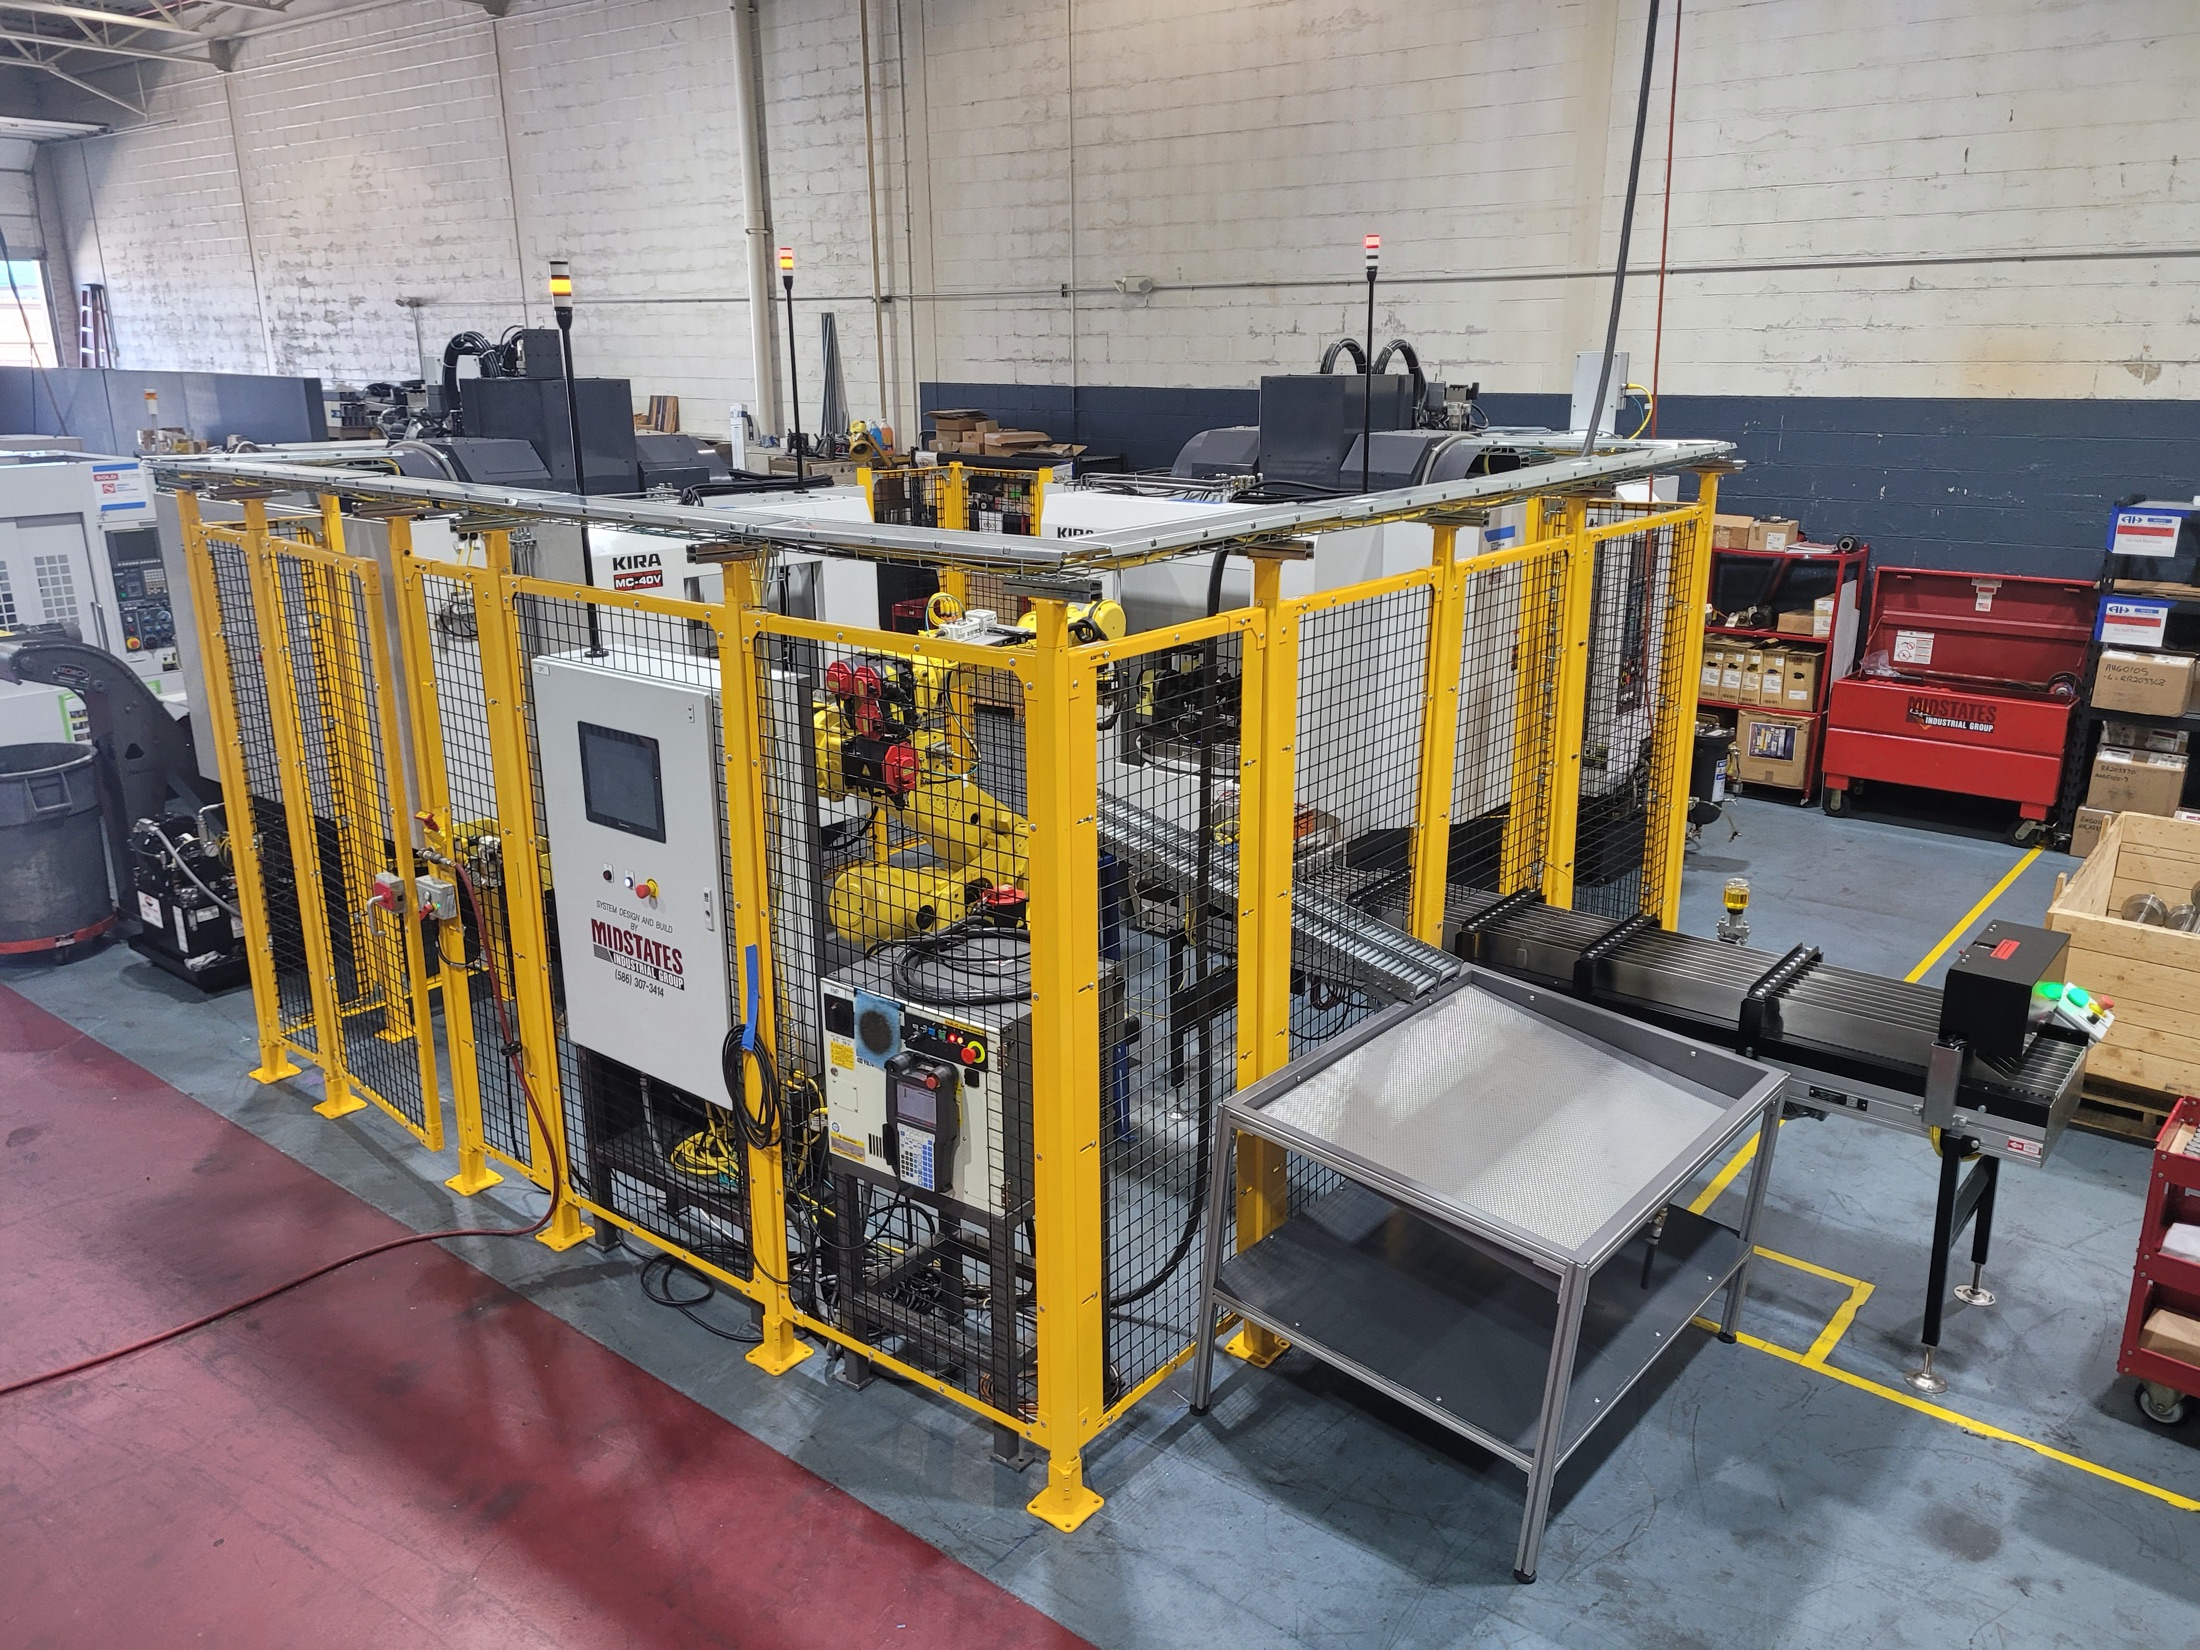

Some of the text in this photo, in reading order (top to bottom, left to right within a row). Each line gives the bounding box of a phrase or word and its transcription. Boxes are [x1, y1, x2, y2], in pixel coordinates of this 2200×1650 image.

[612, 553, 662, 571] KIRA
[615, 574, 662, 588] MC-40V
[1907, 696, 1998, 723] MIDSTATES
[1925, 716, 1994, 733] INDUSTRIAL GROUP
[596, 900, 673, 934] SYSTEM DESIGN AND BUILD
[630, 922, 639, 932] BY
[590, 917, 684, 975] MIDSTATES
[613, 952, 684, 989] INDUSTRIAL GROUP
[614, 968, 665, 998] (586) 307-3414
